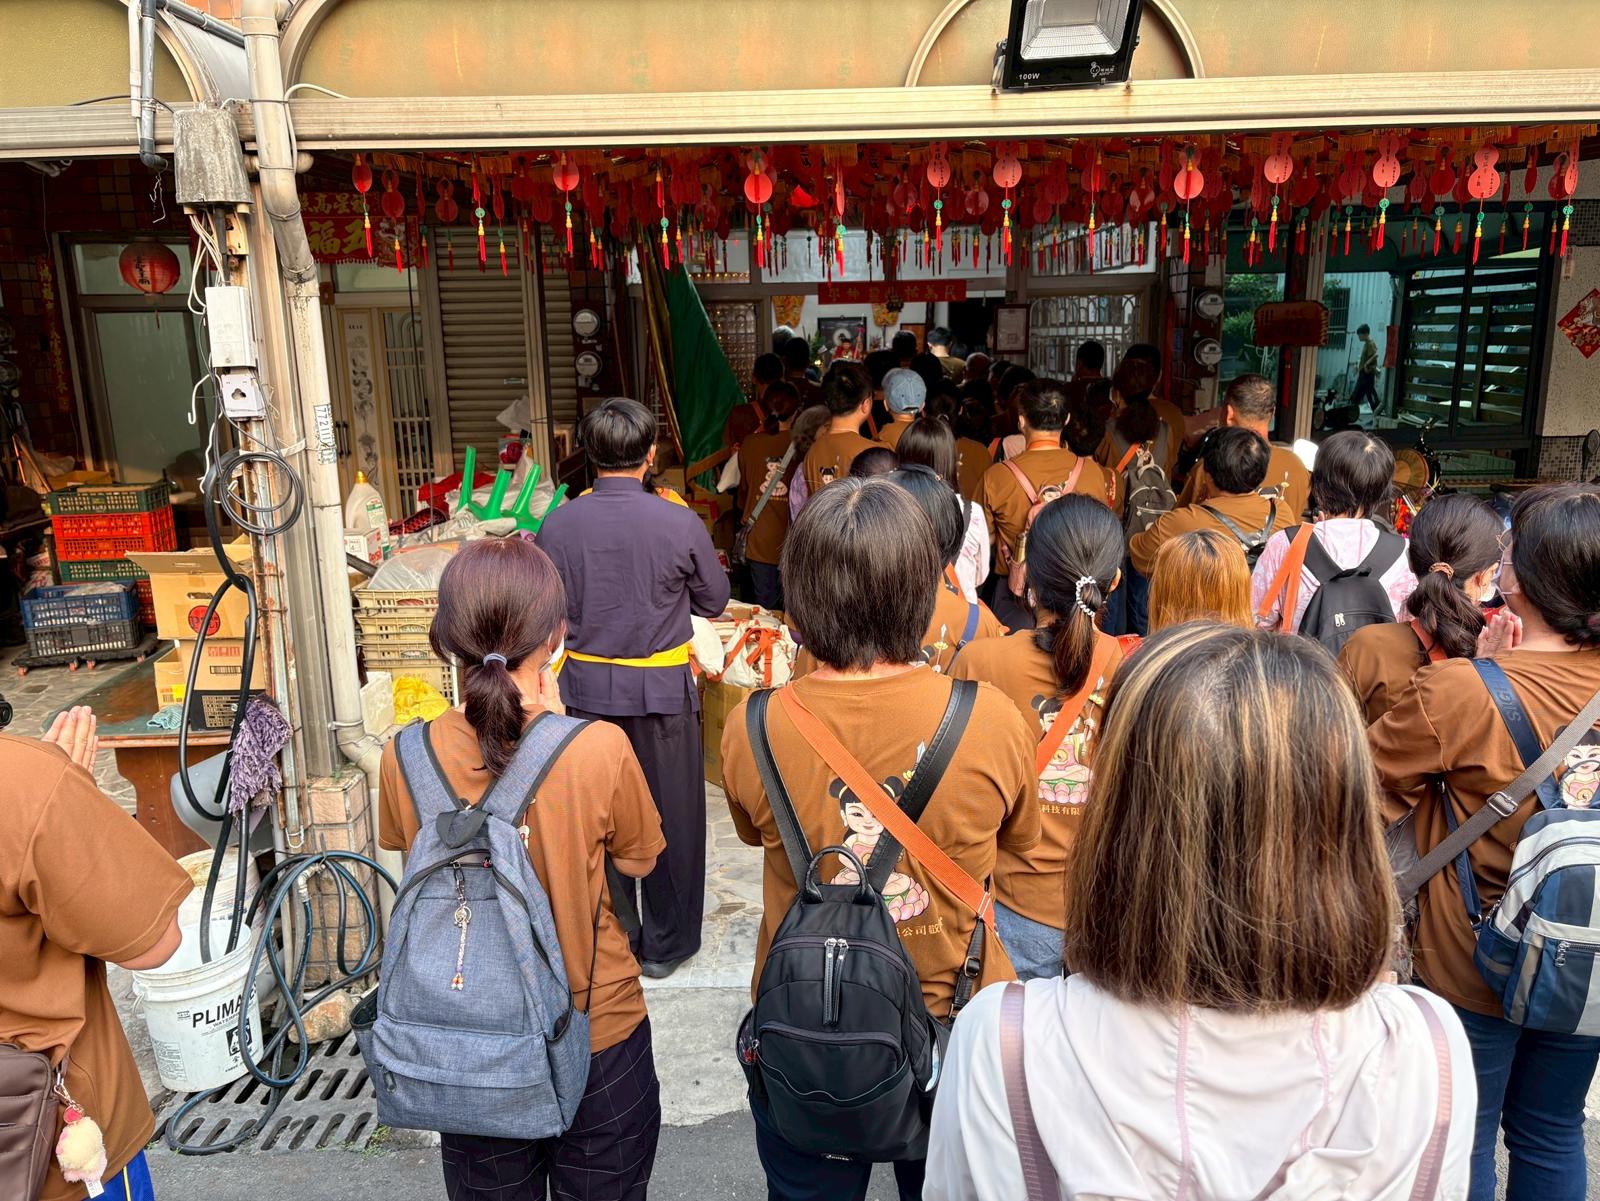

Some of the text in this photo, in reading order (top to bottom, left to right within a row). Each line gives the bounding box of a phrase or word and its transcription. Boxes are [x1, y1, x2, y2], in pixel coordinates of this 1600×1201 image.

[1038, 804, 1081, 816] 科技有限
[896, 917, 943, 937] 公司敬
